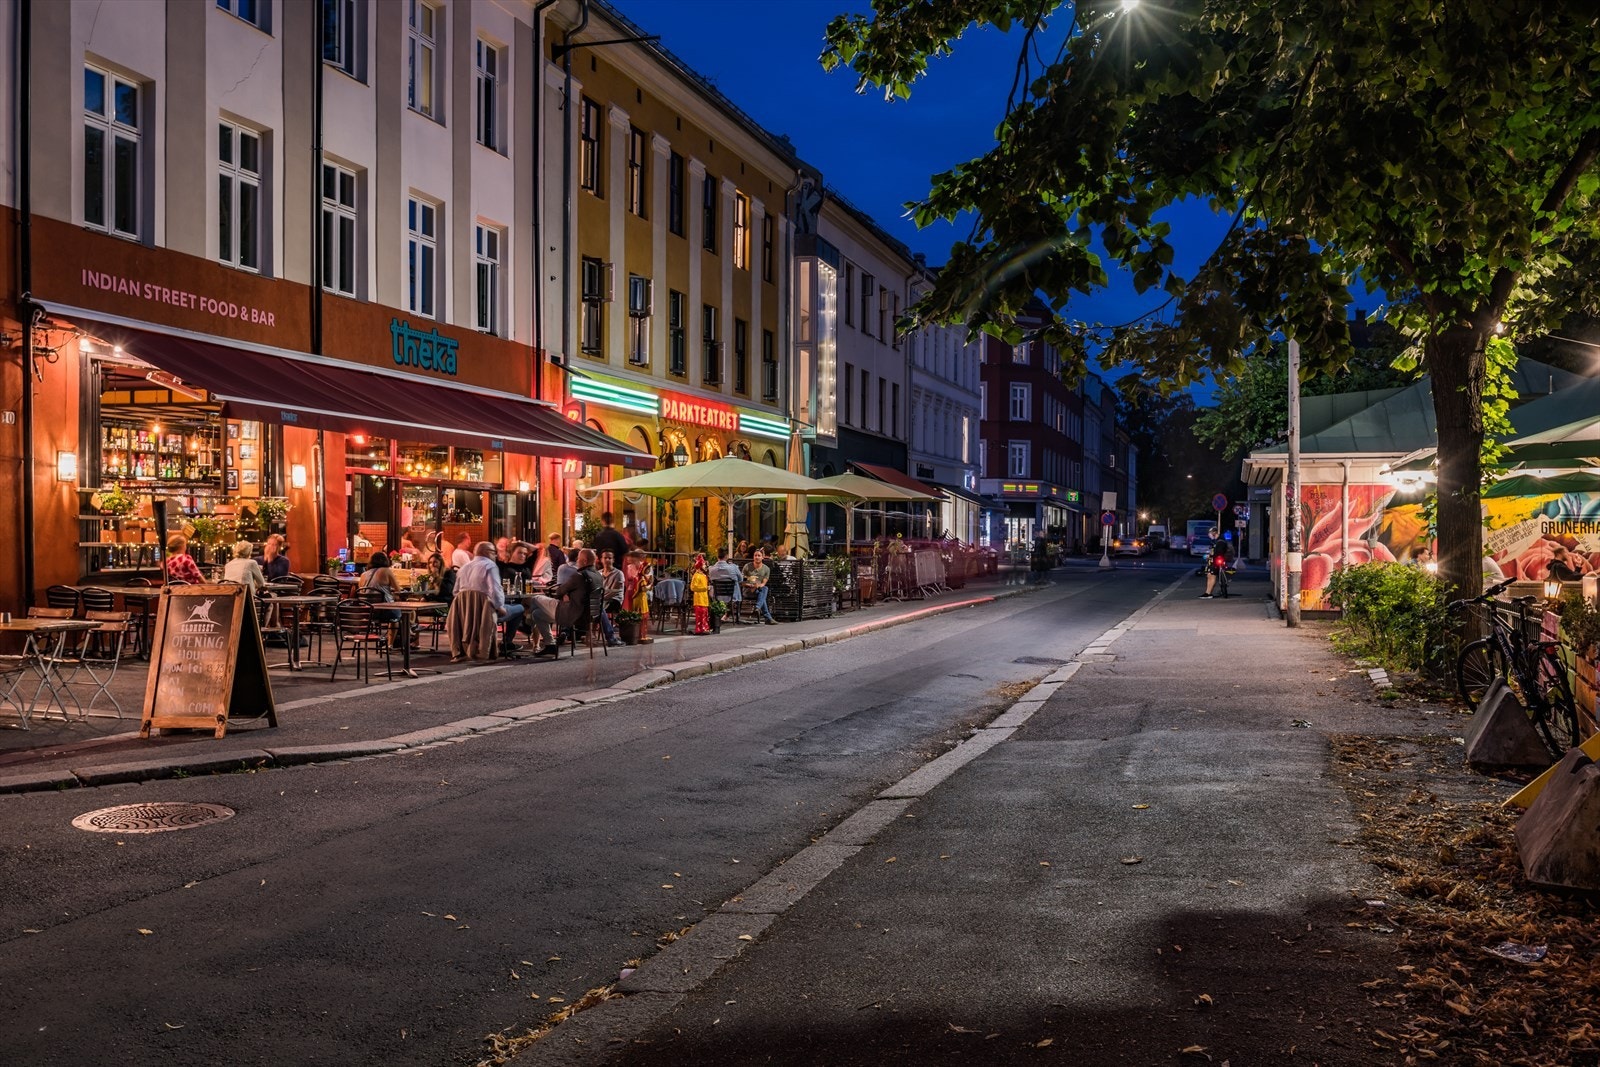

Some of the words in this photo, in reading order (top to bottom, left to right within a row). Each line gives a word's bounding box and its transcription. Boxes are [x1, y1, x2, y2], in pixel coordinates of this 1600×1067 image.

[81, 269, 140, 297] INDIAN
[144, 283, 197, 309] STREET
[200, 296, 238, 318] FOOD
[240, 306, 248, 321] &
[251, 308, 275, 327] BAR
[391, 318, 458, 374] theka
[662, 398, 738, 431] PARKTEATRET
